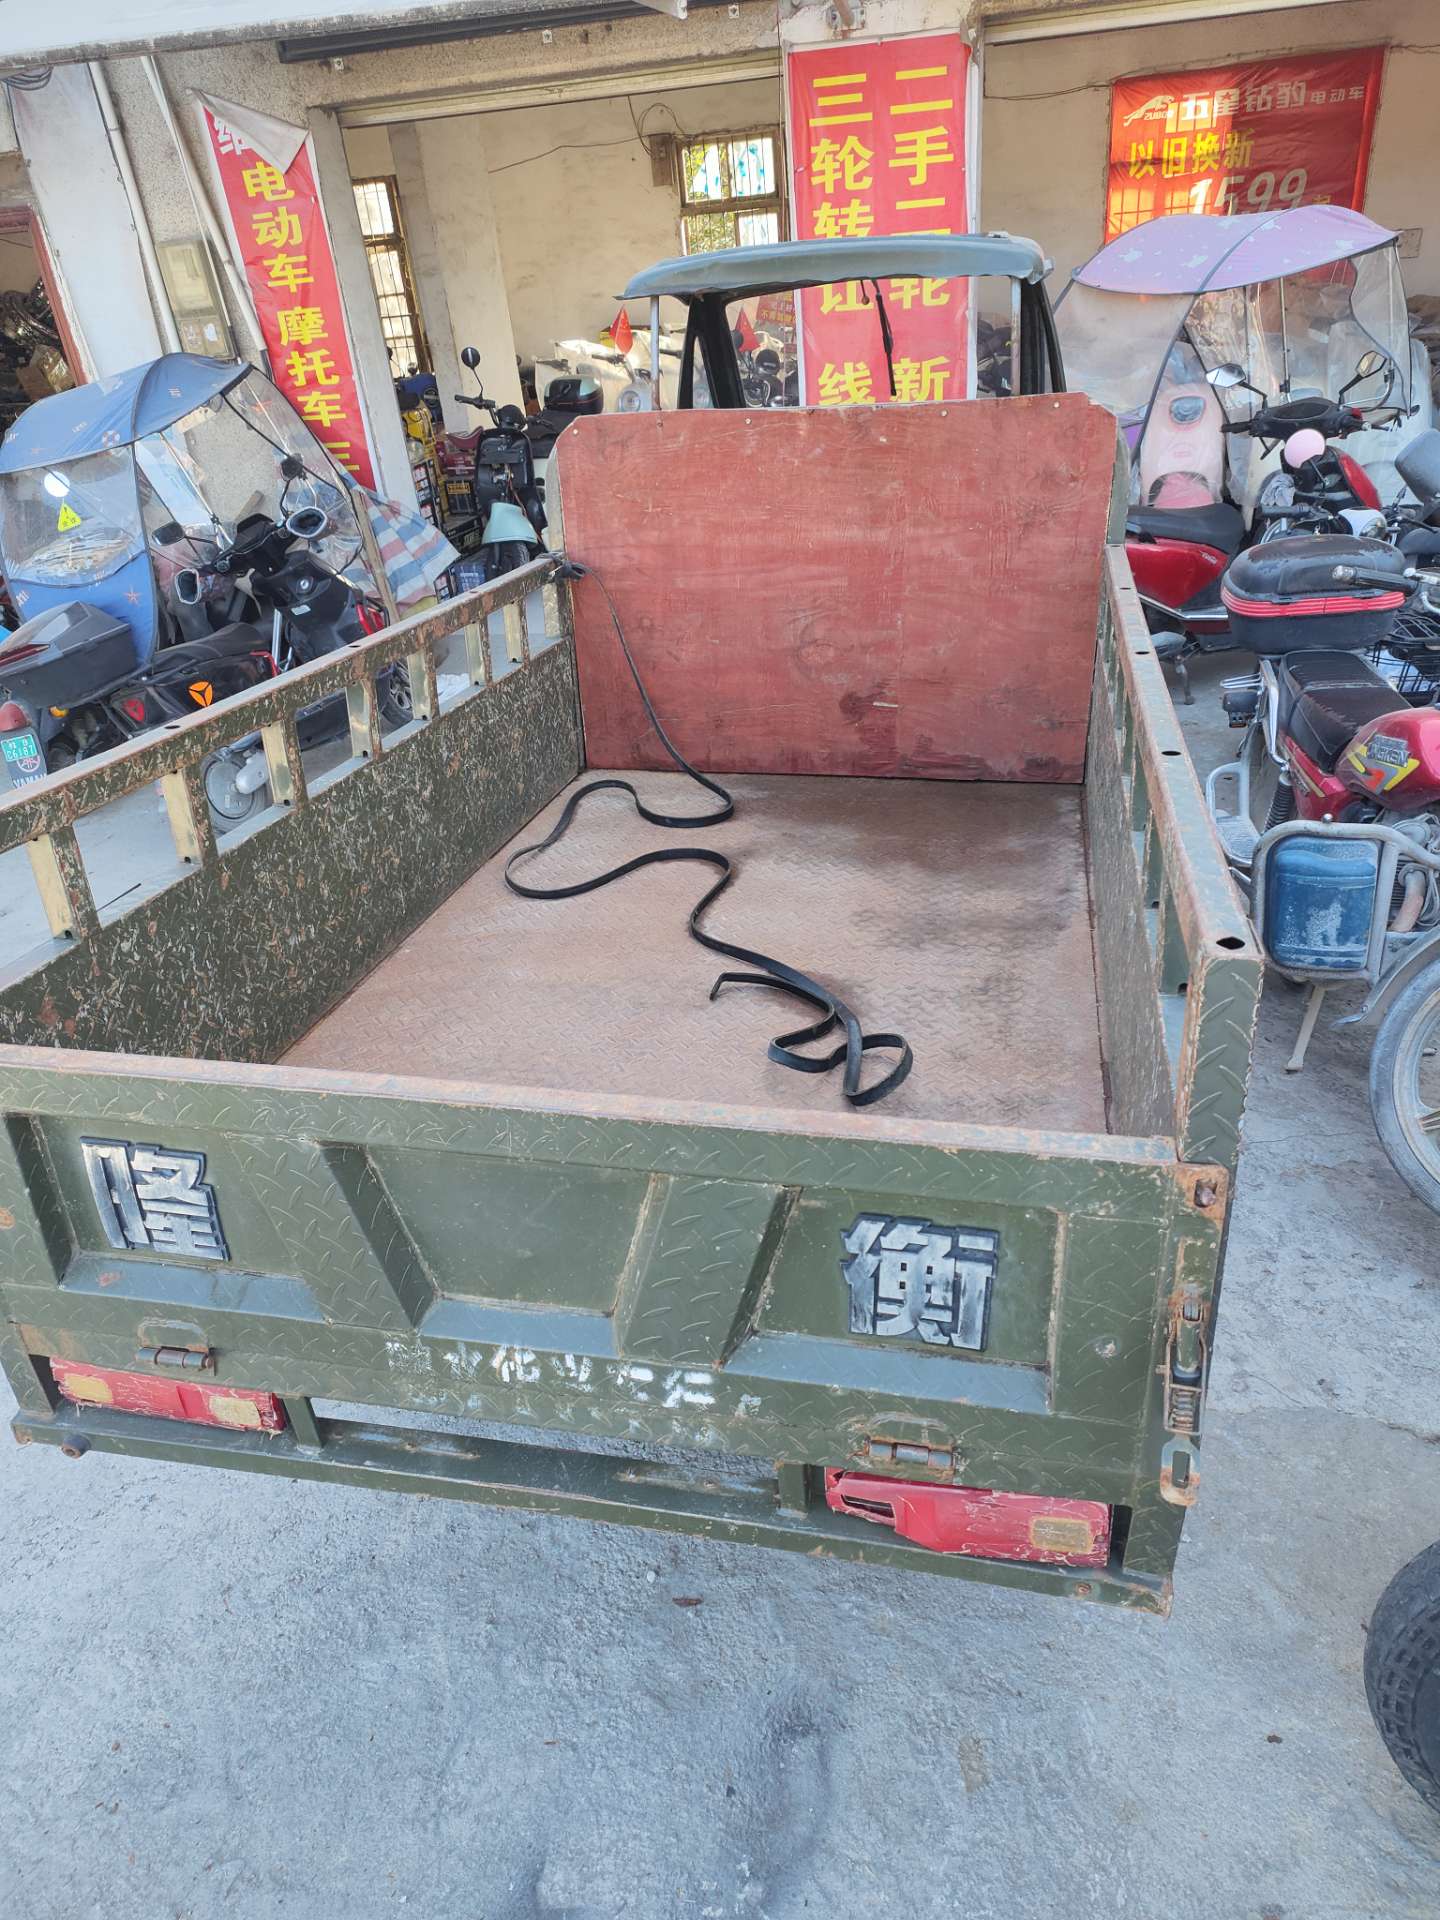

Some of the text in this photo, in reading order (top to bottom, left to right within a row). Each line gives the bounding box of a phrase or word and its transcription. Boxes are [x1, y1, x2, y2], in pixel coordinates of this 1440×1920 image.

[1181, 81, 1364, 121] 五星钻豹 电动车
[1129, 128, 1255, 179] 以旧换新
[1190, 168, 1308, 217] 1599
[242, 161, 315, 294] 电动车
[277, 306, 347, 428] 摩托车
[891, 355, 951, 402] 新
